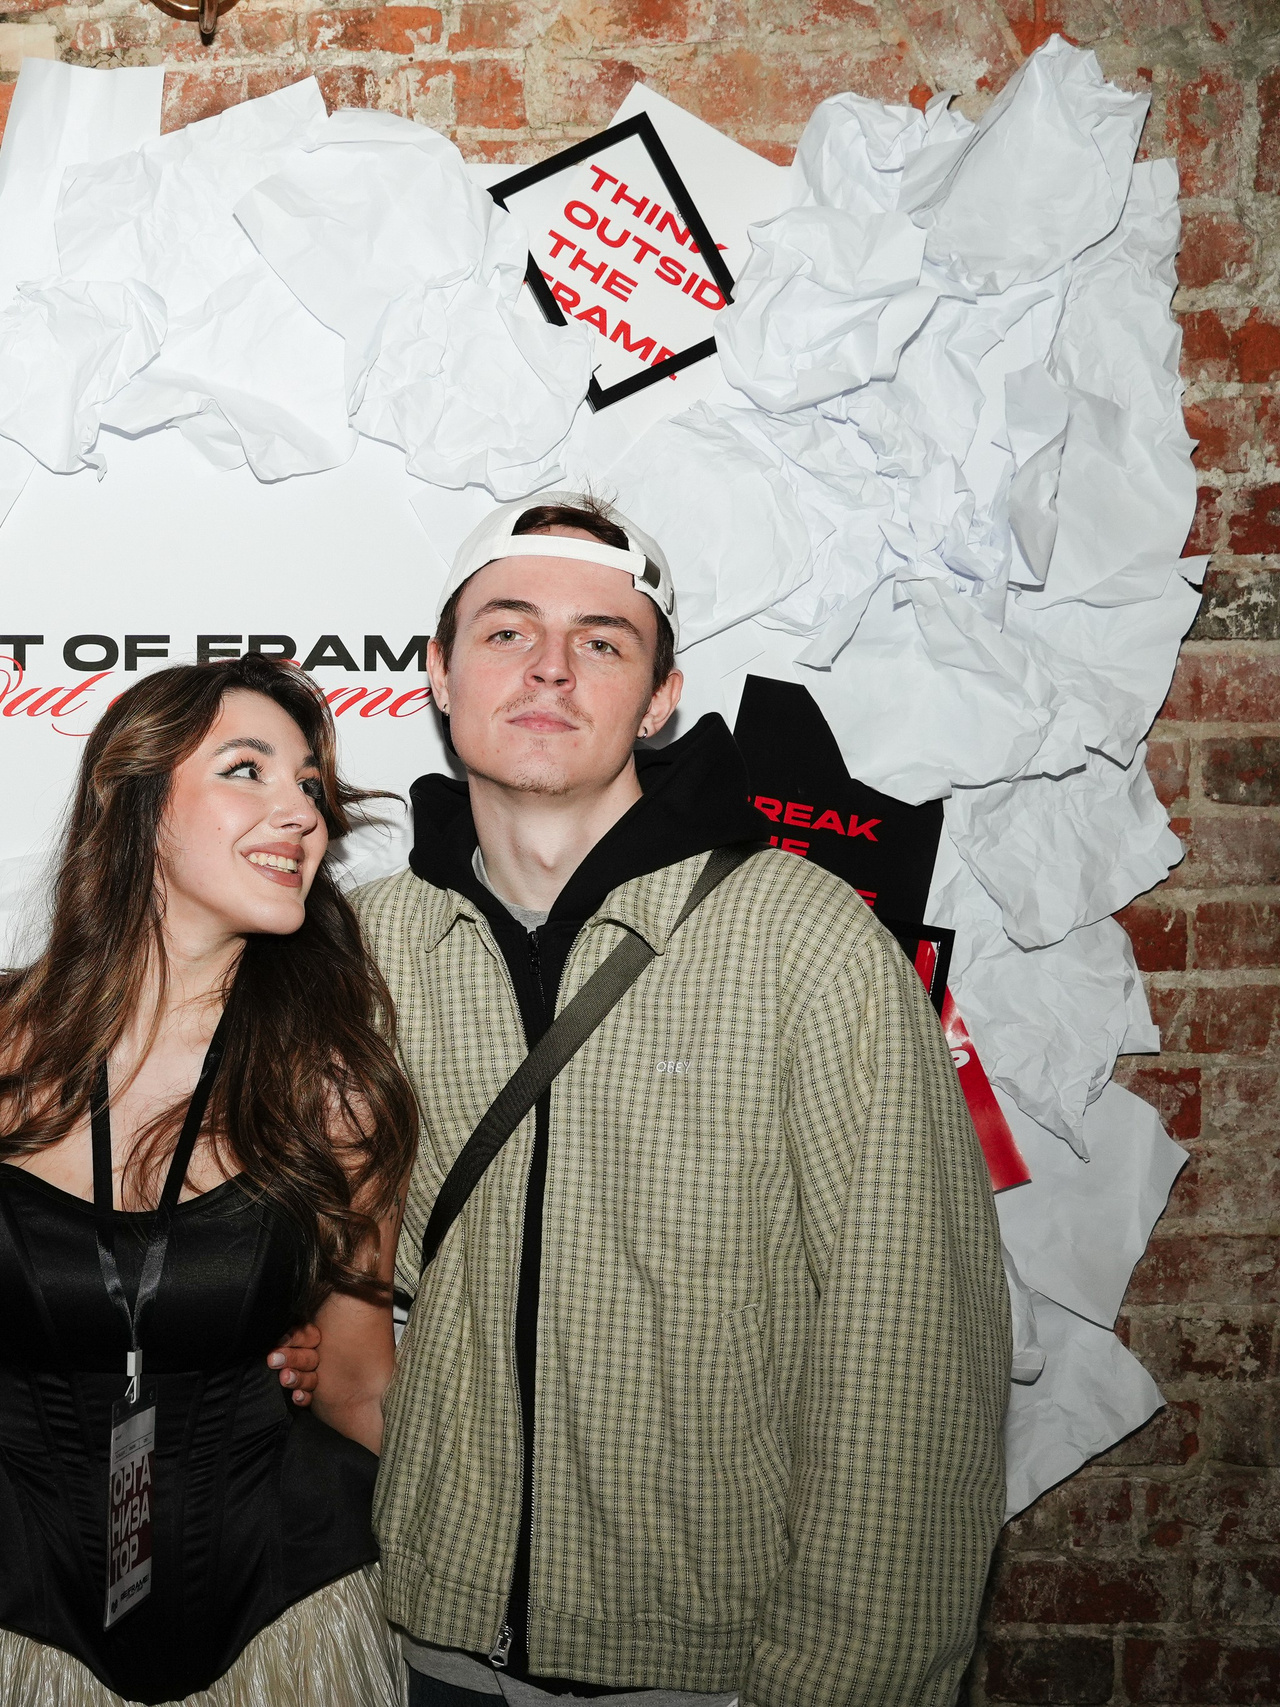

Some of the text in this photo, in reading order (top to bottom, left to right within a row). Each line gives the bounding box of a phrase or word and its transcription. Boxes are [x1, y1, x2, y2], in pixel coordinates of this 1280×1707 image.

[590, 164, 729, 253] THIN
[548, 229, 638, 303] THE
[564, 200, 728, 311] OUTSID
[62, 634, 171, 672] OF
[196, 634, 431, 672] FRAM
[748, 795, 883, 842] REAK
[656, 1061, 691, 1073] OBEY
[113, 1453, 151, 1506] ОРГА
[111, 1490, 150, 1547] НИЗА
[112, 1533, 139, 1583] ТОР
